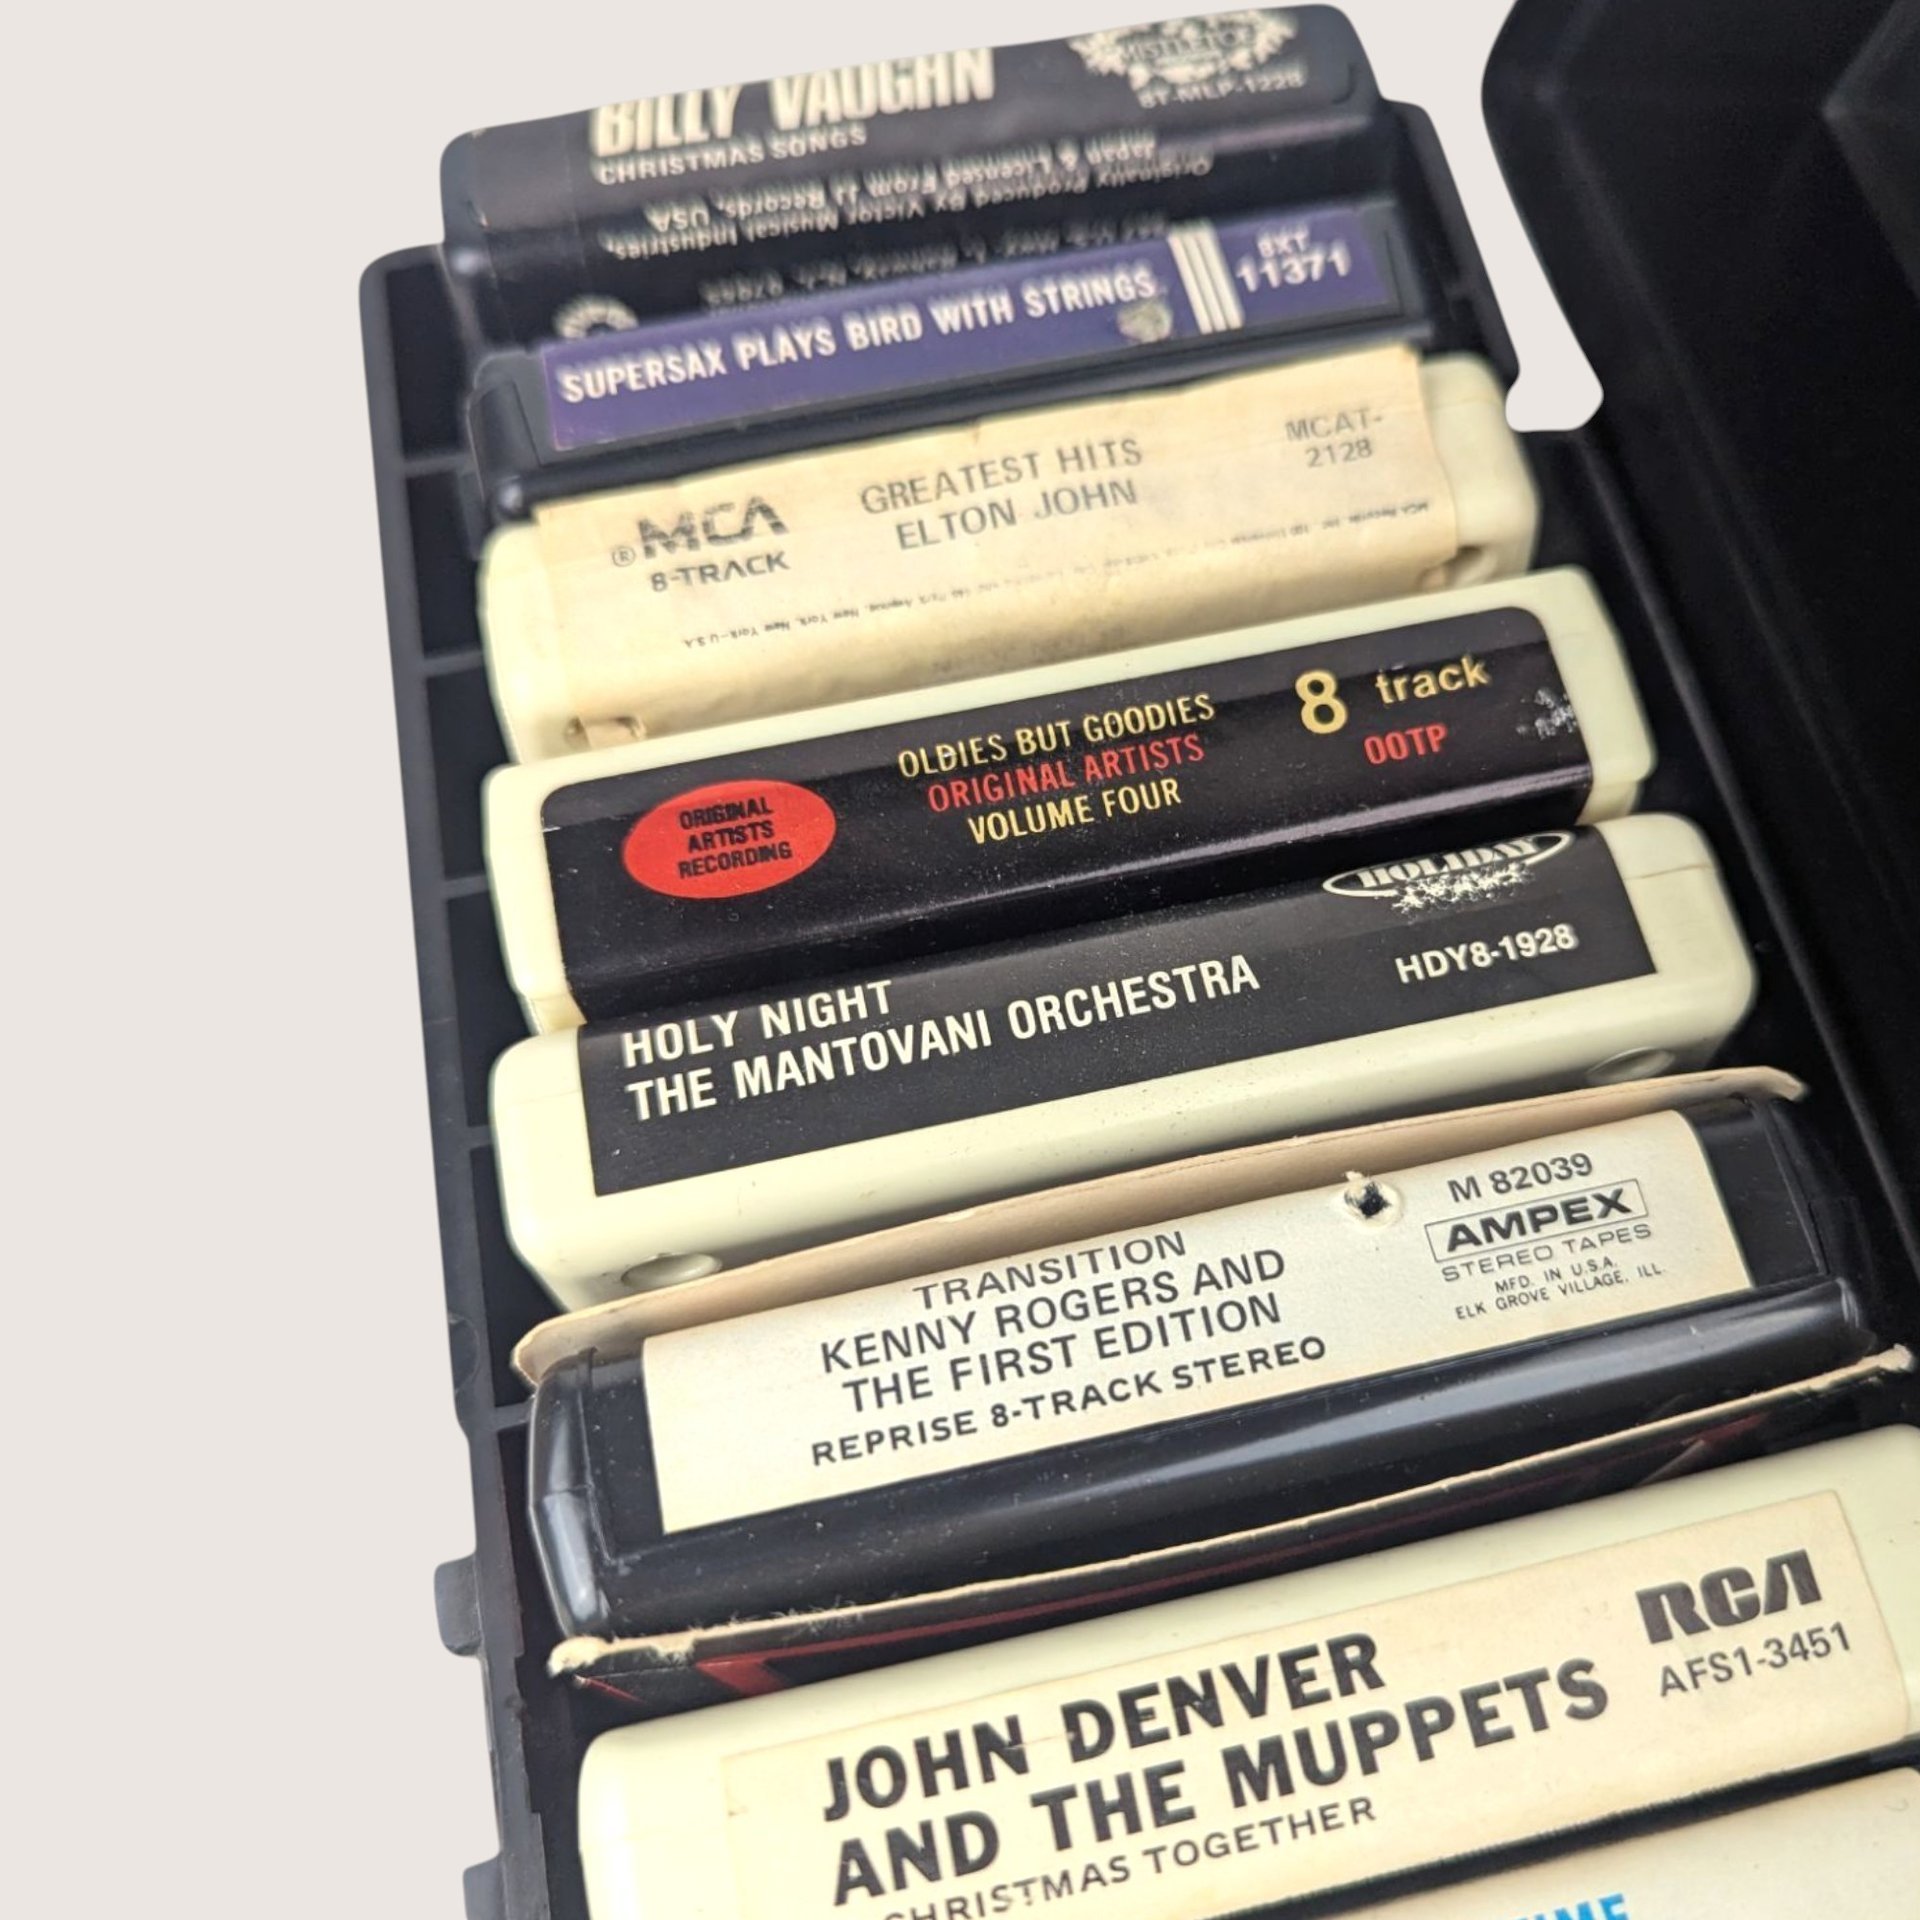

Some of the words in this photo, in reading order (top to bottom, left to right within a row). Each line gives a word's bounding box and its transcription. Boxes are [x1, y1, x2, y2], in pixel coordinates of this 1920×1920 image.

[593, 84, 743, 157] BILLY
[770, 47, 994, 131] VAUGHN
[597, 139, 765, 185] CHRISTMAS
[767, 125, 867, 159] SONGS
[645, 201, 710, 232] USA
[1237, 242, 1351, 292] 11371
[558, 340, 727, 403] SUPERSAX
[734, 320, 836, 371] PLAYS
[844, 306, 923, 351] BIRD
[930, 287, 1015, 335] WITH
[1023, 264, 1156, 318] STRINGS
[1284, 408, 1384, 441] MCAT-
[1305, 438, 1373, 467] 2128
[858, 452, 1041, 515] GREATEST
[1056, 438, 1143, 474] HITS
[637, 495, 790, 560] MCA
[896, 499, 1017, 550] ELTON
[1034, 480, 1138, 520] JOHN
[650, 551, 791, 592] 8-TRACK
[1294, 668, 1348, 734] 8
[1375, 652, 1491, 708] track
[897, 733, 1008, 778] OLDIES
[1015, 720, 1072, 756] BUT
[1082, 693, 1215, 742] GOODIES
[927, 758, 1075, 813] ORIGINAL
[1083, 733, 1206, 783] ARTISTS
[679, 796, 773, 830] ORIGINAL
[688, 820, 775, 853] ARTISTS
[967, 794, 1095, 844] VOLUME
[1101, 777, 1182, 818] FOUR
[678, 841, 792, 879] RECORDING
[1394, 923, 1579, 983] HDY8-1928
[620, 1010, 738, 1068] HOLY
[759, 979, 892, 1039] NIGHT
[624, 1067, 717, 1121] THE
[732, 1009, 992, 1099] MANTOVANI
[1007, 954, 1260, 1040] ORCHESTRA
[1447, 1175, 1482, 1203] M
[1489, 1152, 1593, 1195] 82039
[1441, 1245, 1554, 1282] STEREO
[1562, 1223, 1652, 1254] TAPES
[1447, 1187, 1632, 1252] AMPEX
[912, 1231, 1186, 1310] TRANSITION
[1455, 1303, 1487, 1320] ELK
[1495, 1287, 1550, 1311] GROVE
[1495, 1274, 1535, 1293] MFD.
[1545, 1268, 1562, 1282] IN
[821, 1310, 976, 1374] KENNY
[995, 1271, 1179, 1337] ROGERS
[1194, 1249, 1285, 1296] AND
[842, 1365, 933, 1412] THE
[950, 1333, 1077, 1391] FIRST
[1094, 1292, 1281, 1360] EDITION
[812, 1410, 978, 1466] REPRISE
[990, 1370, 1162, 1428] 8-TRACK
[1172, 1336, 1326, 1389] STEREO
[1635, 1548, 1822, 1644] RCA
[1660, 1621, 1850, 1697] AFS1-3451
[823, 1714, 1029, 1822] JOHN
[1060, 1632, 1386, 1763] DENVER
[833, 1810, 1000, 1906] AND
[1030, 1759, 1197, 1852] THE
[1221, 1657, 1608, 1808] MUPPETS
[1142, 1796, 1377, 1875] TOGETHER
